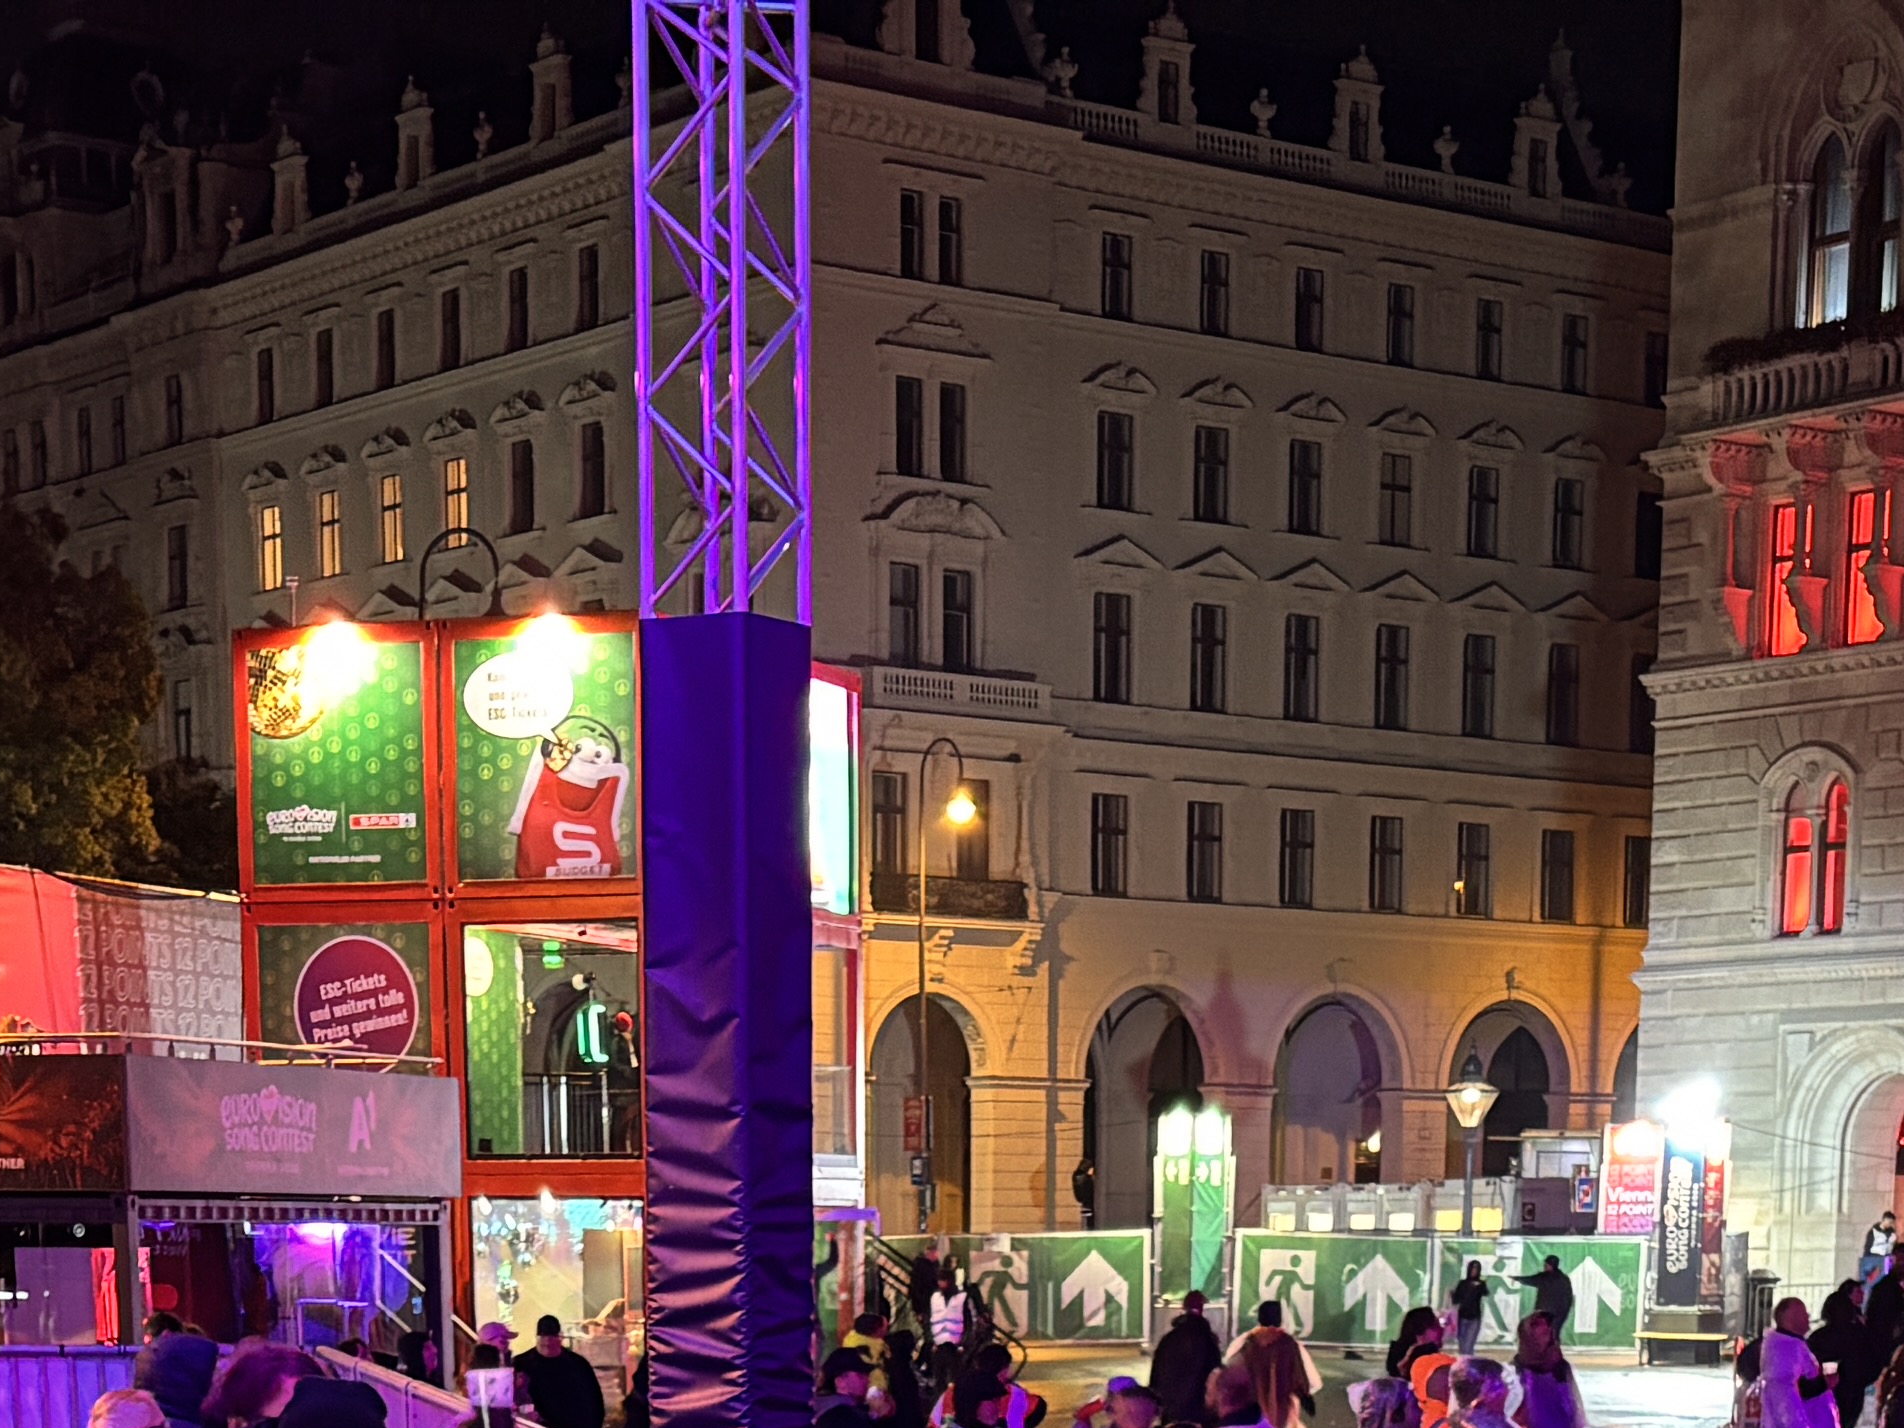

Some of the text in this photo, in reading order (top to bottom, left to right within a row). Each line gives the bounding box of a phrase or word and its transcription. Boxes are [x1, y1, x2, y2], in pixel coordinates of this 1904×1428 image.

[319, 973, 388, 1001] ESC-Tickets
[309, 988, 405, 1023] und weitere tolle
[312, 1023, 351, 1042] Preise
[349, 1089, 377, 1154] A1
[260, 1126, 316, 1153] CONTEST
